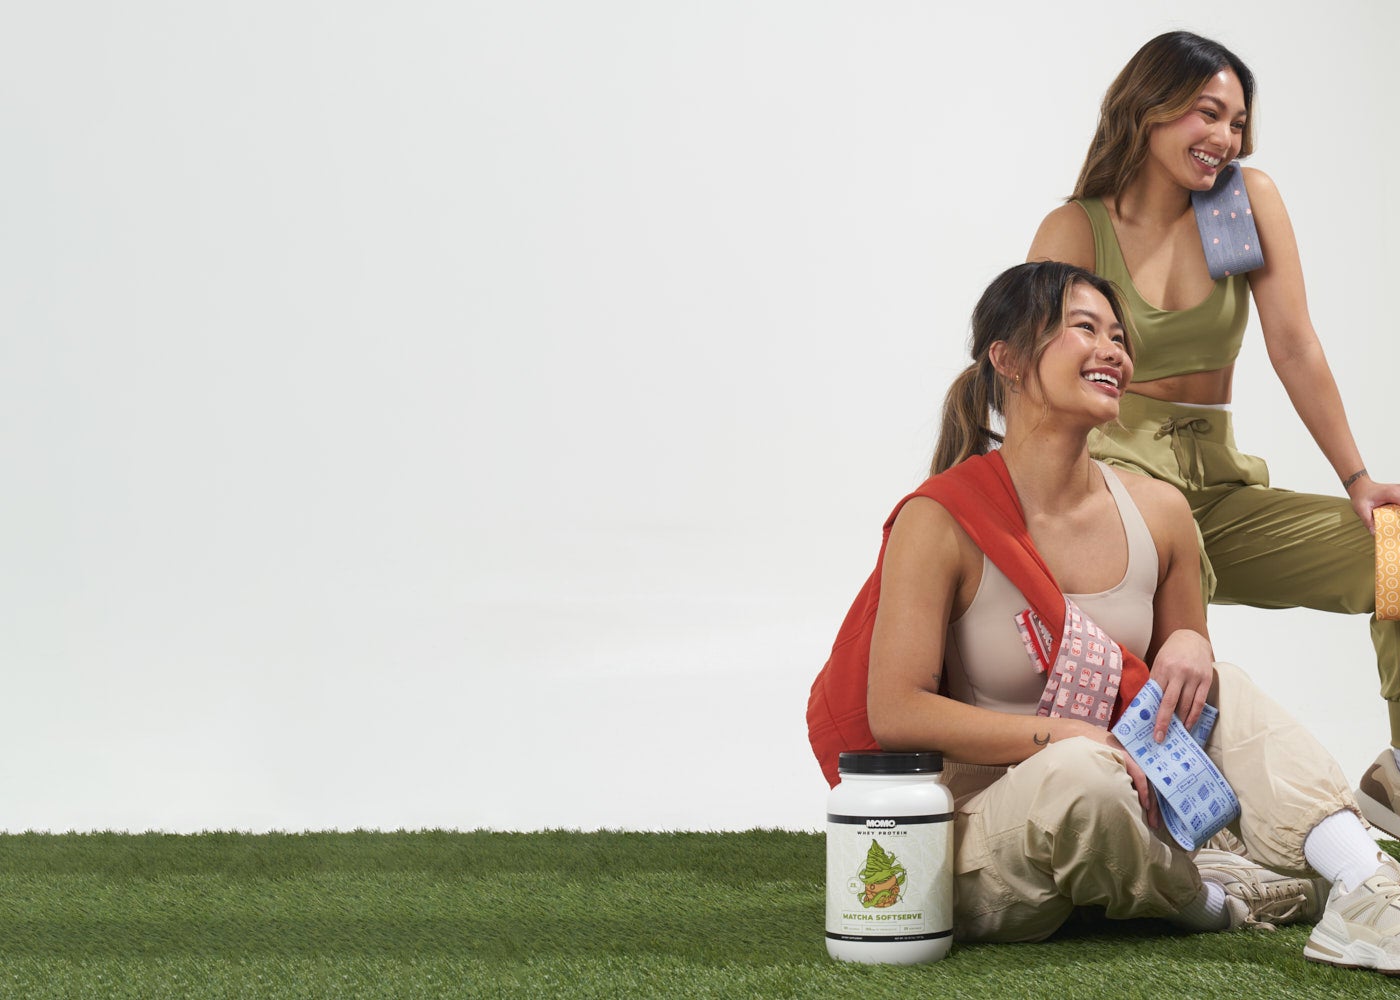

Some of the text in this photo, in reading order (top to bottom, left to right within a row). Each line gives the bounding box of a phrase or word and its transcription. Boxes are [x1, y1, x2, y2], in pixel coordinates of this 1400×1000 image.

[866, 819, 896, 829] MOMO
[842, 913, 922, 921] MATCHA SOFTSERVE
